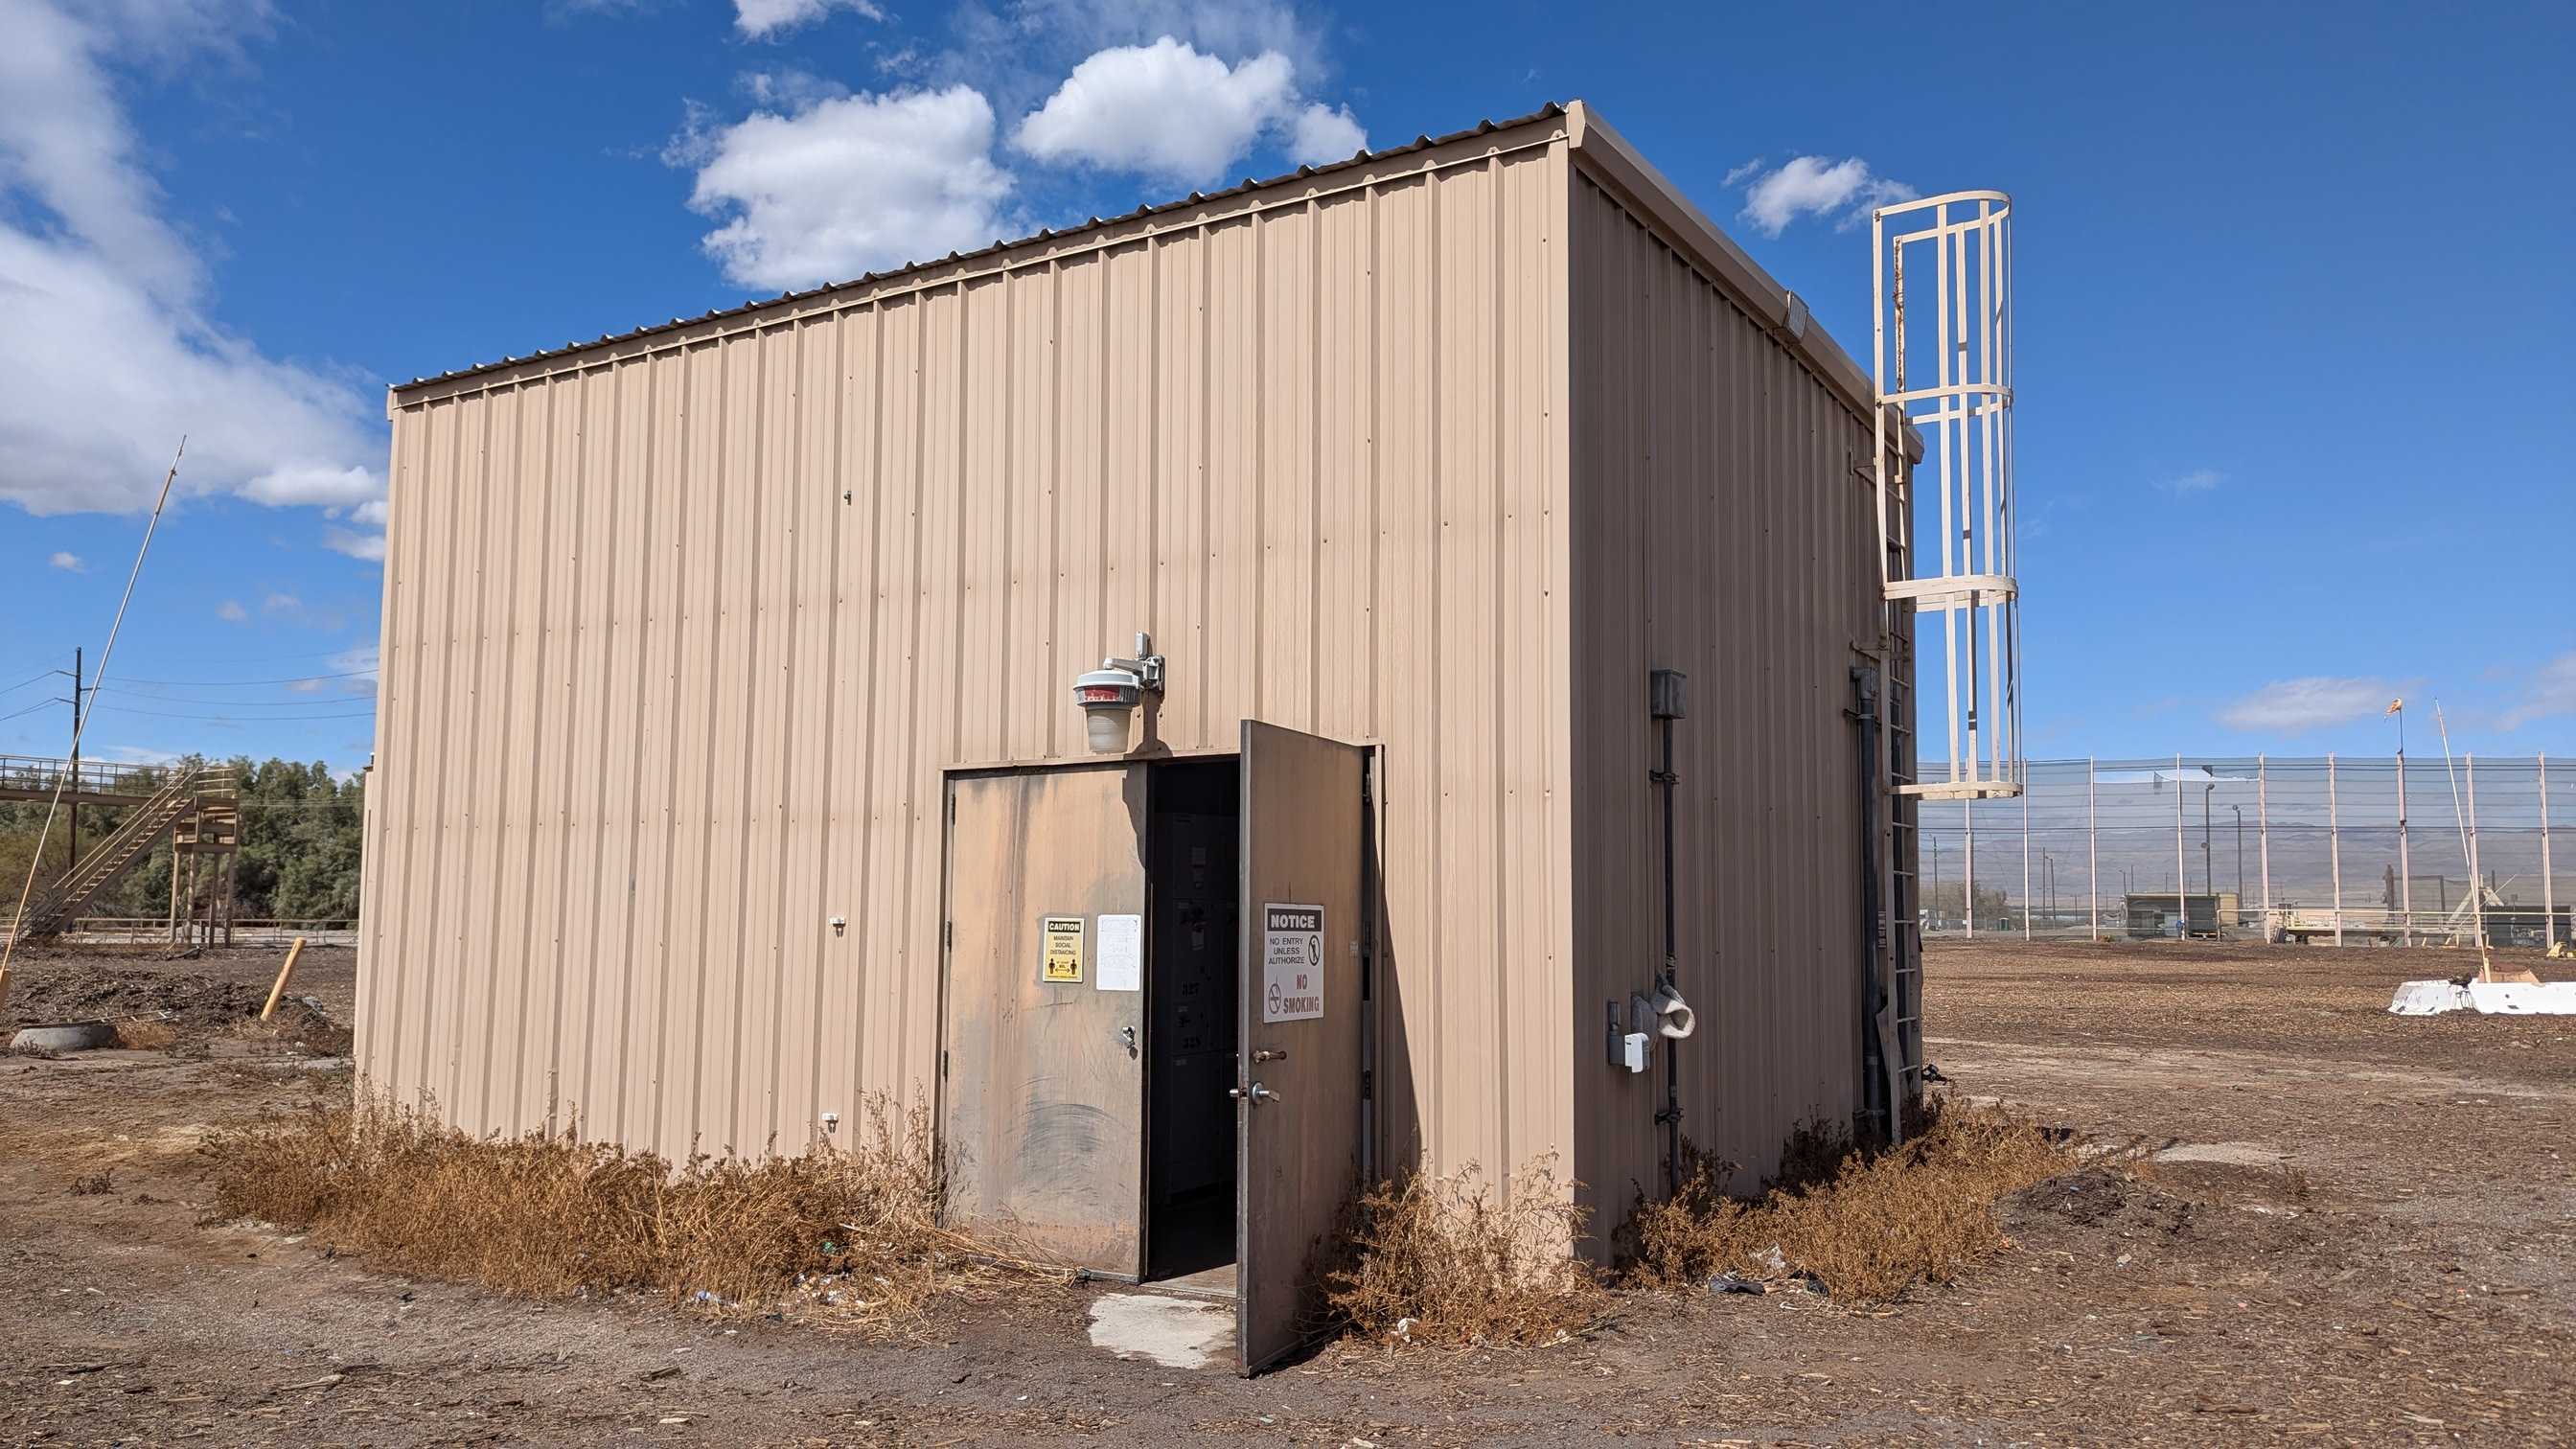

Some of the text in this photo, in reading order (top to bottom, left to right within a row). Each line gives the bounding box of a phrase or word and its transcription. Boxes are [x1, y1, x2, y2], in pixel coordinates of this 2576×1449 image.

[1270, 914, 1315, 929] NOTICE
[1048, 923, 1080, 932] CAUTION
[1270, 937, 1280, 946] NO
[1273, 947, 1300, 955] UNLESS
[1268, 956, 1305, 965] AUTHORIZE
[1296, 974, 1308, 990] NO
[1283, 996, 1320, 1014] SMOKING
